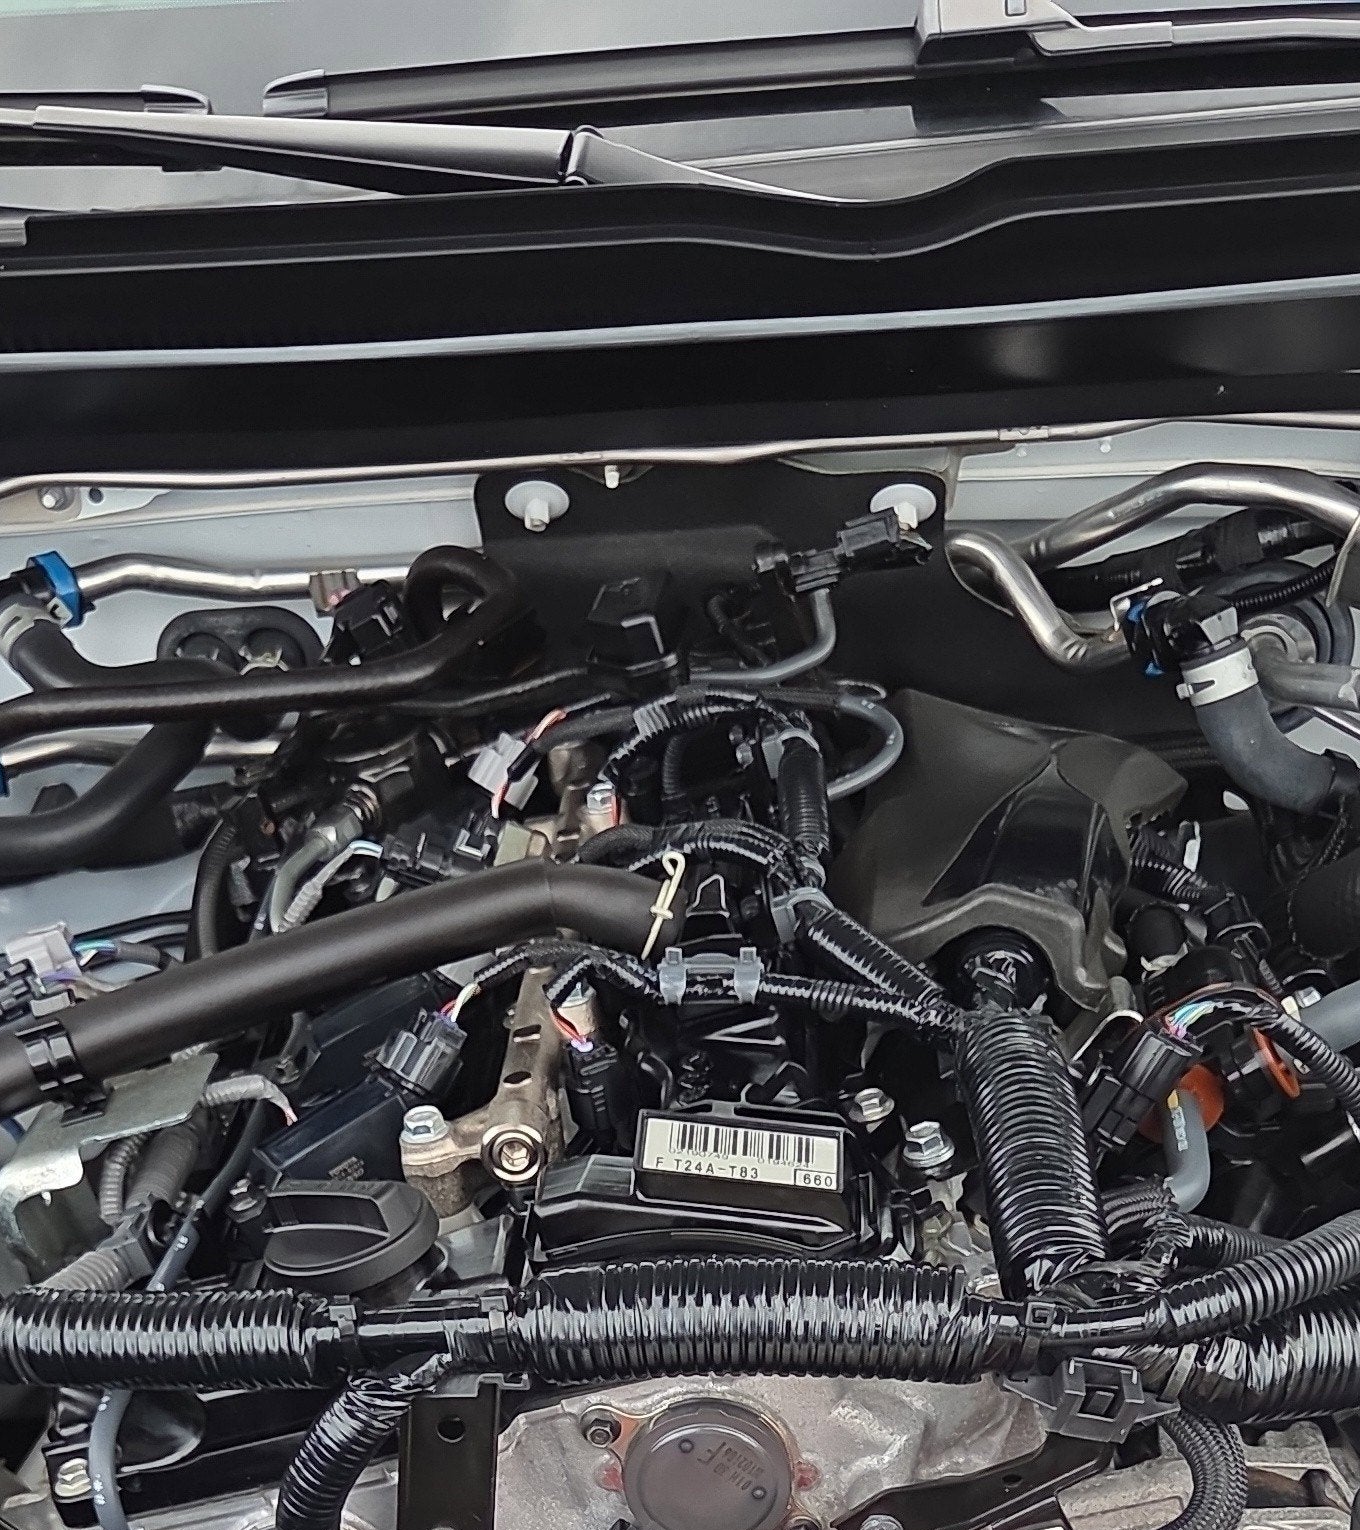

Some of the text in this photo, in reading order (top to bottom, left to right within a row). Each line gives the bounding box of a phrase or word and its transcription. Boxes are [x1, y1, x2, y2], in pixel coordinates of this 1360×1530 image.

[655, 1157, 759, 1180] F T24A-T83
[803, 1174, 833, 1188] 660
